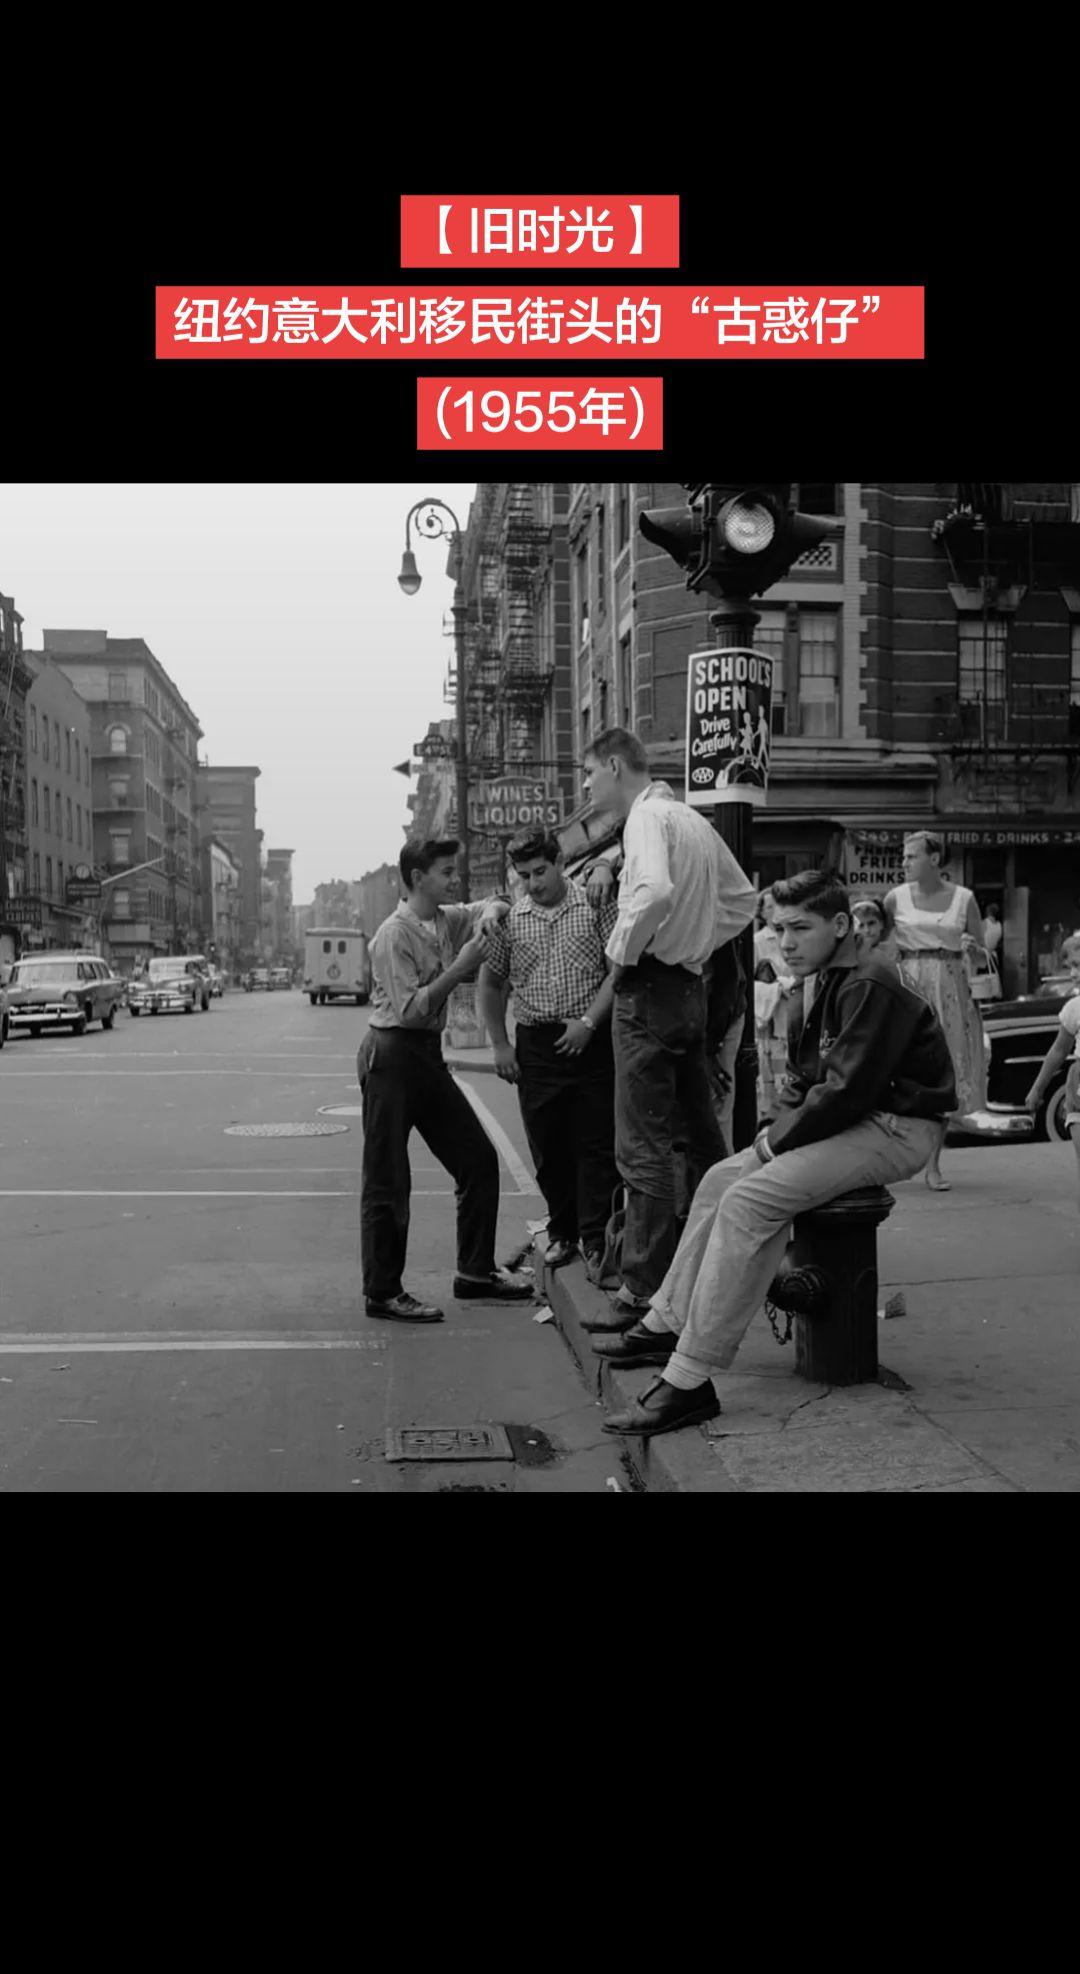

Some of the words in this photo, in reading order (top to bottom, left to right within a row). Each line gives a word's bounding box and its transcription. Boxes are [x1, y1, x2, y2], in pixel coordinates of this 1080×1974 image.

[695, 656, 771, 689] SCHOOL'S
[694, 685, 747, 714] OPEN
[699, 715, 731, 735] Drive
[692, 733, 738, 757] Carefully
[487, 785, 544, 802] WINES
[473, 806, 558, 826] LIQUORS
[947, 831, 980, 844] FRIED
[997, 831, 1049, 844] DRINKS
[860, 856, 904, 869] FRIES
[849, 872, 905, 884] DRINKS
